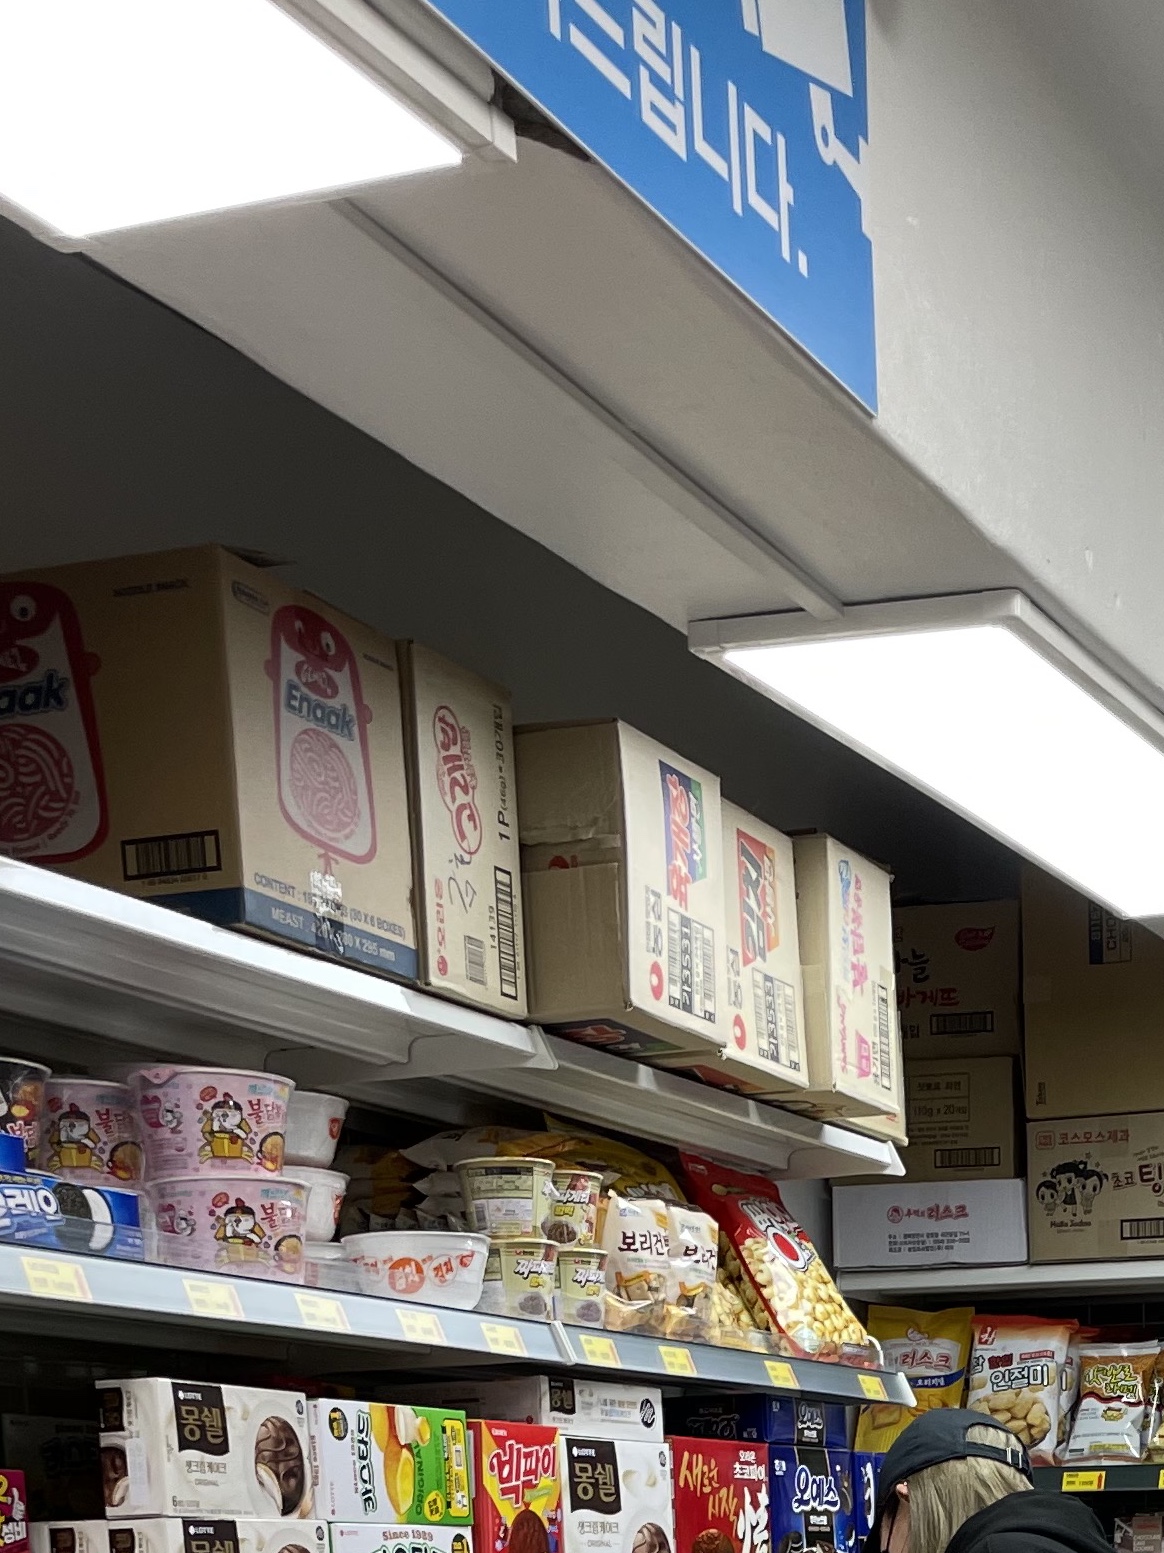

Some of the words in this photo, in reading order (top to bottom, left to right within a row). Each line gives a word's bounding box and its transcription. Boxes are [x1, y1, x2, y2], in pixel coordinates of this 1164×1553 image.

[284, 679, 356, 742] Enaak
[437, 714, 478, 843] 고래밥
[666, 774, 692, 911] 육개장
[253, 872, 298, 900] CONTENT
[648, 889, 663, 957] 농심
[1058, 1128, 1130, 1146] 코스모스제과
[900, 1348, 953, 1371] 러스크
[989, 1363, 1049, 1392] 인절미
[180, 1404, 228, 1442] 몽쉘
[357, 1409, 377, 1516] 카스타드
[488, 1440, 559, 1508] 빅파이
[572, 1462, 617, 1502] 몽쉘
[678, 1450, 720, 1497] 새로운
[733, 1463, 768, 1481] 초코파이
[792, 1464, 841, 1513] 오예스
[382, 1529, 410, 1541] Since
